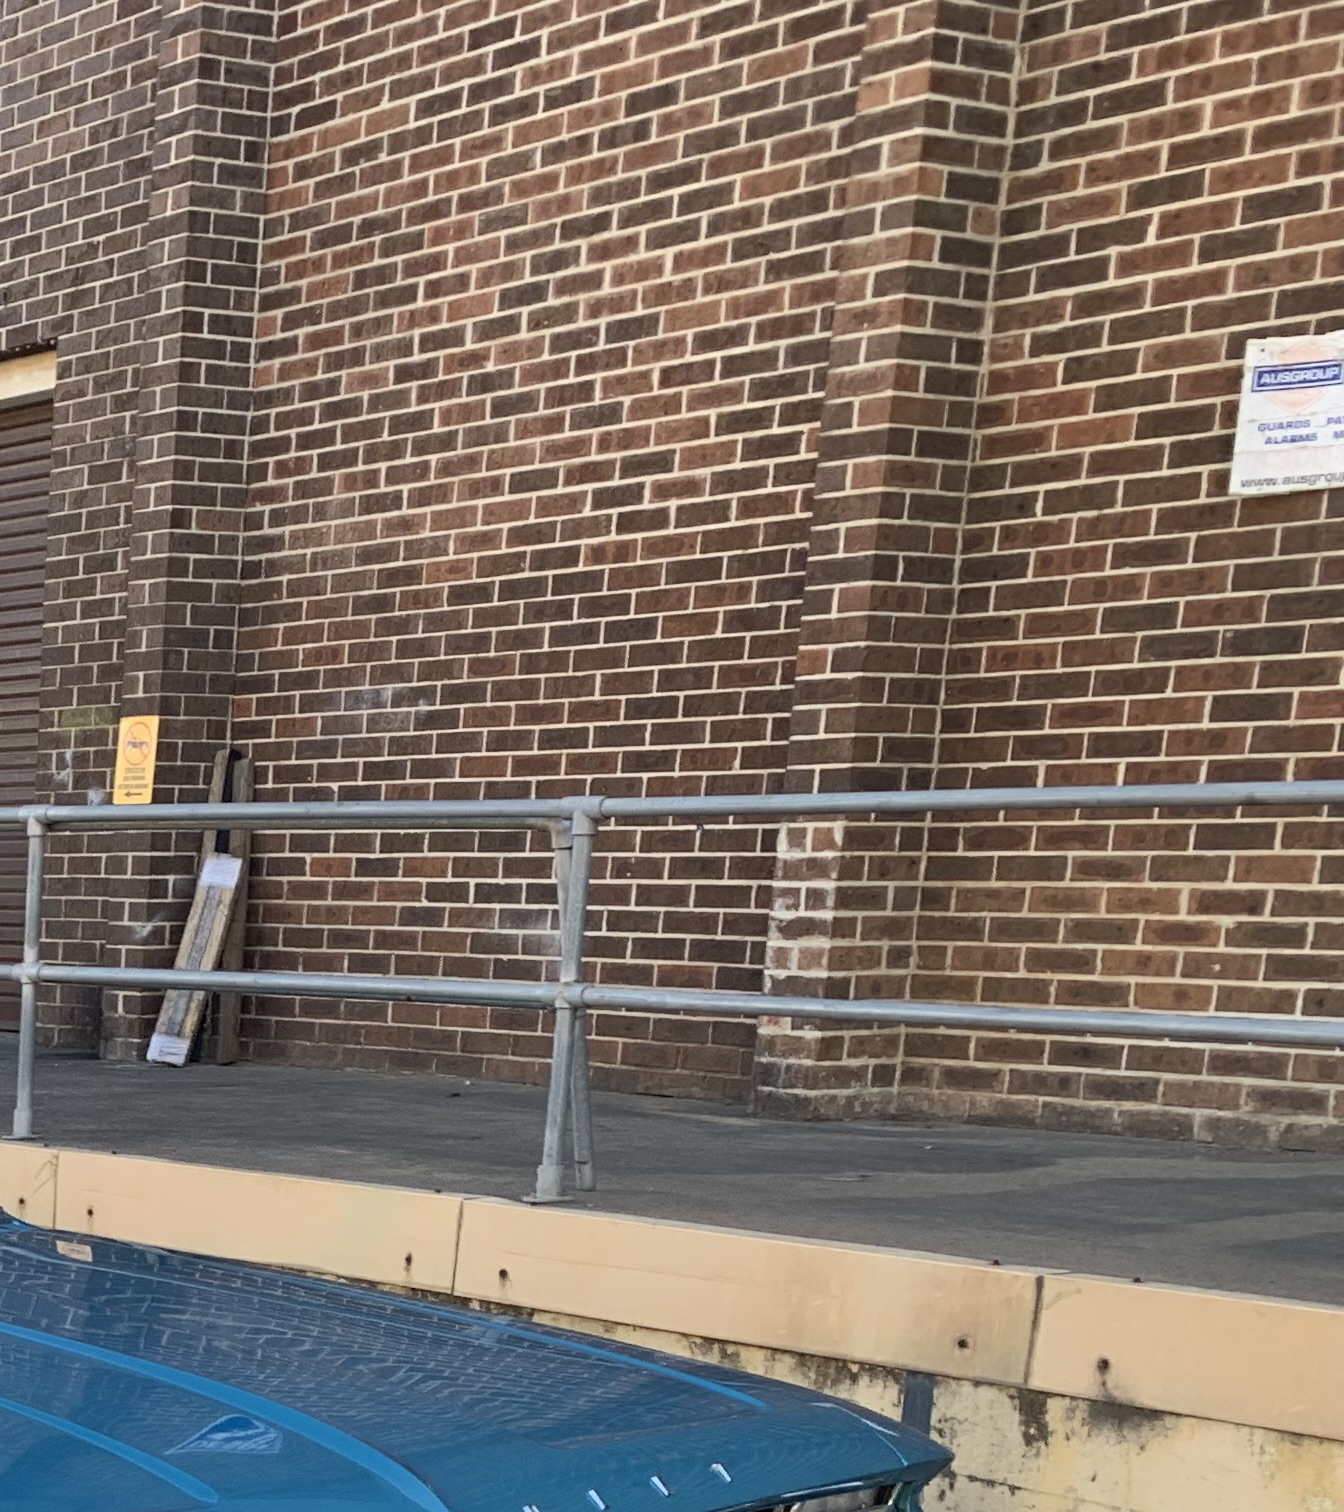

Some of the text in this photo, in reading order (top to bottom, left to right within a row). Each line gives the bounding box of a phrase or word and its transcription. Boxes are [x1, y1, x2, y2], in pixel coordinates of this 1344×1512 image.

[1260, 367, 1338, 384] AUSGROUP
[1258, 420, 1310, 431] GUARDS
[1265, 433, 1317, 445] ALARMS
